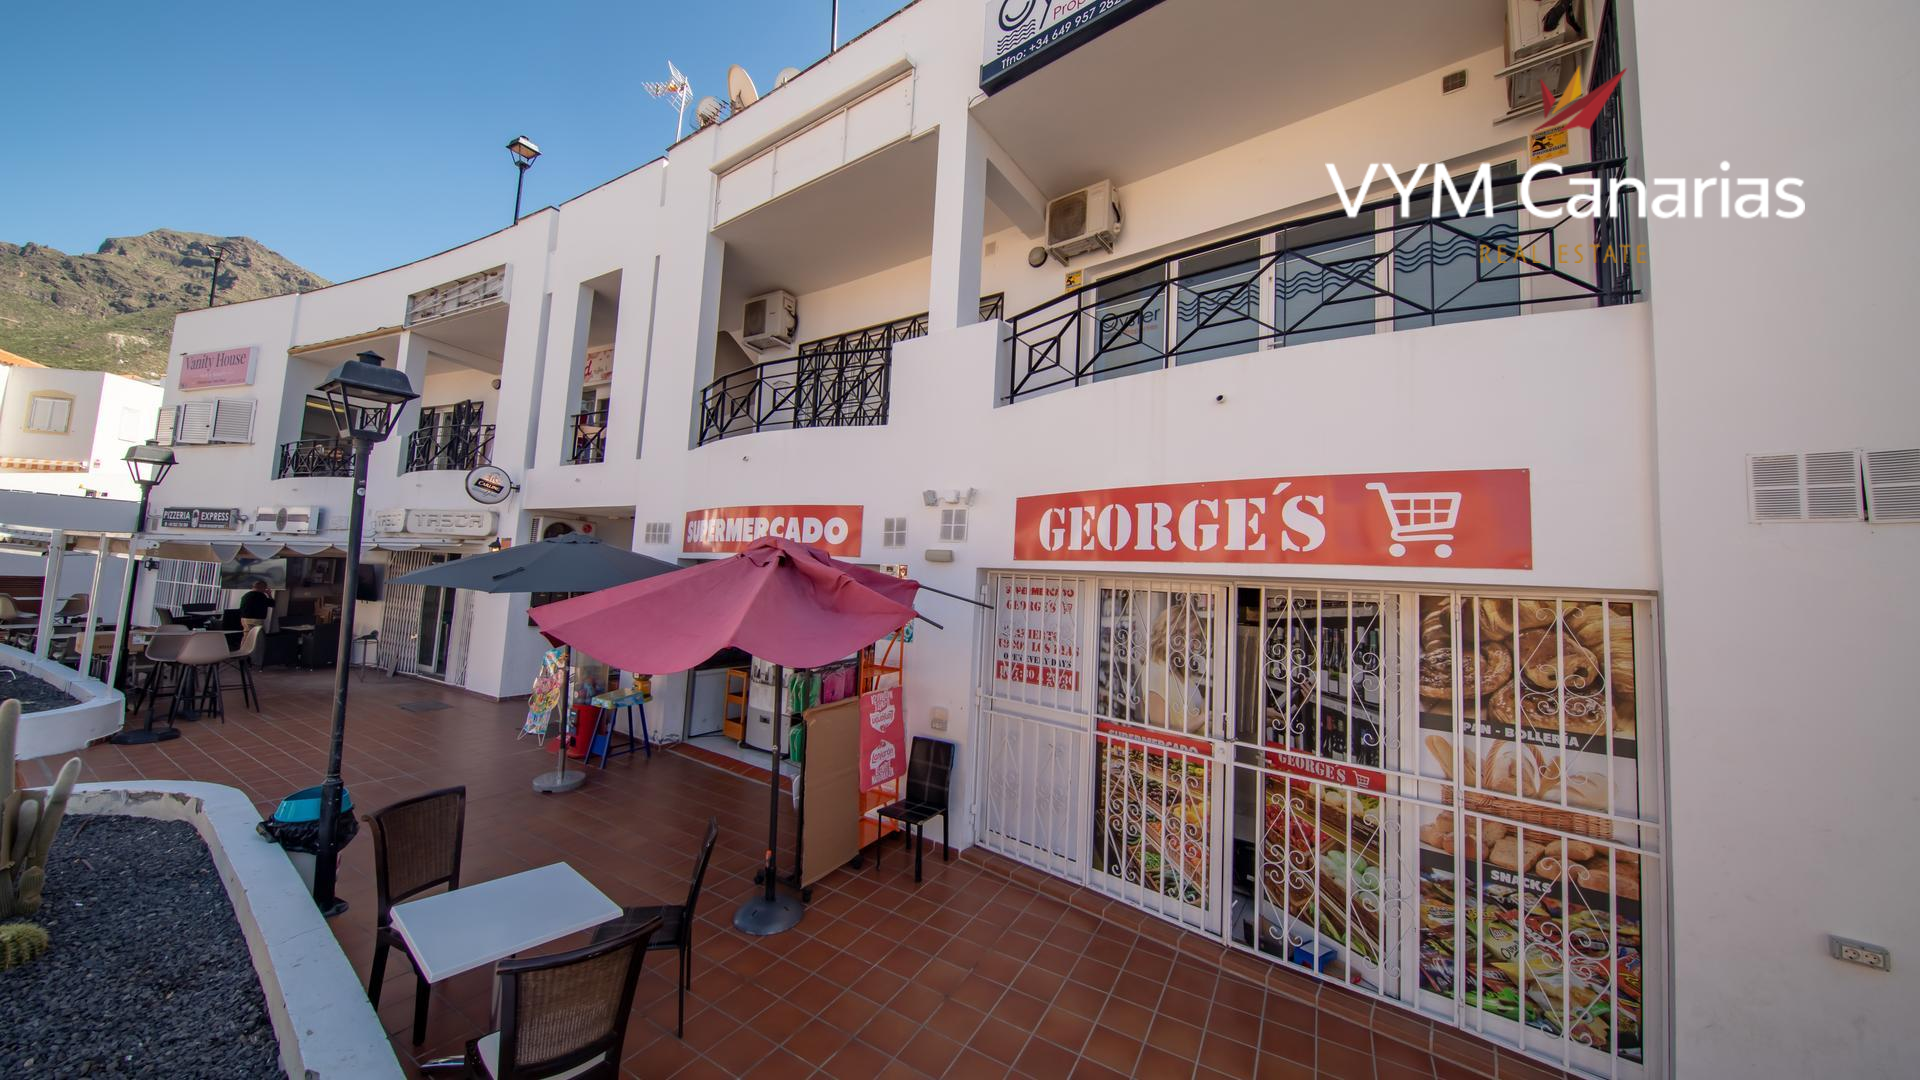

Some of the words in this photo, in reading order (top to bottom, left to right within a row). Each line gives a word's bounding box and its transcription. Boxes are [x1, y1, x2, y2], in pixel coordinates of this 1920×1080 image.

[1001, 50, 1027, 69] Tfno:
[1030, 35, 1049, 51] +34
[1051, 22, 1072, 40] 649
[1075, 8, 1096, 27] 957
[186, 353, 213, 371] Vanity
[216, 352, 247, 368] House
[163, 510, 191, 520] PIZZERIA
[201, 511, 229, 521] EXPRESS
[414, 513, 484, 529] TASCA
[687, 516, 849, 545] SUPERMERCADO
[1463, 722, 1491, 736] PAN
[1491, 869, 1552, 893] SNACKS
